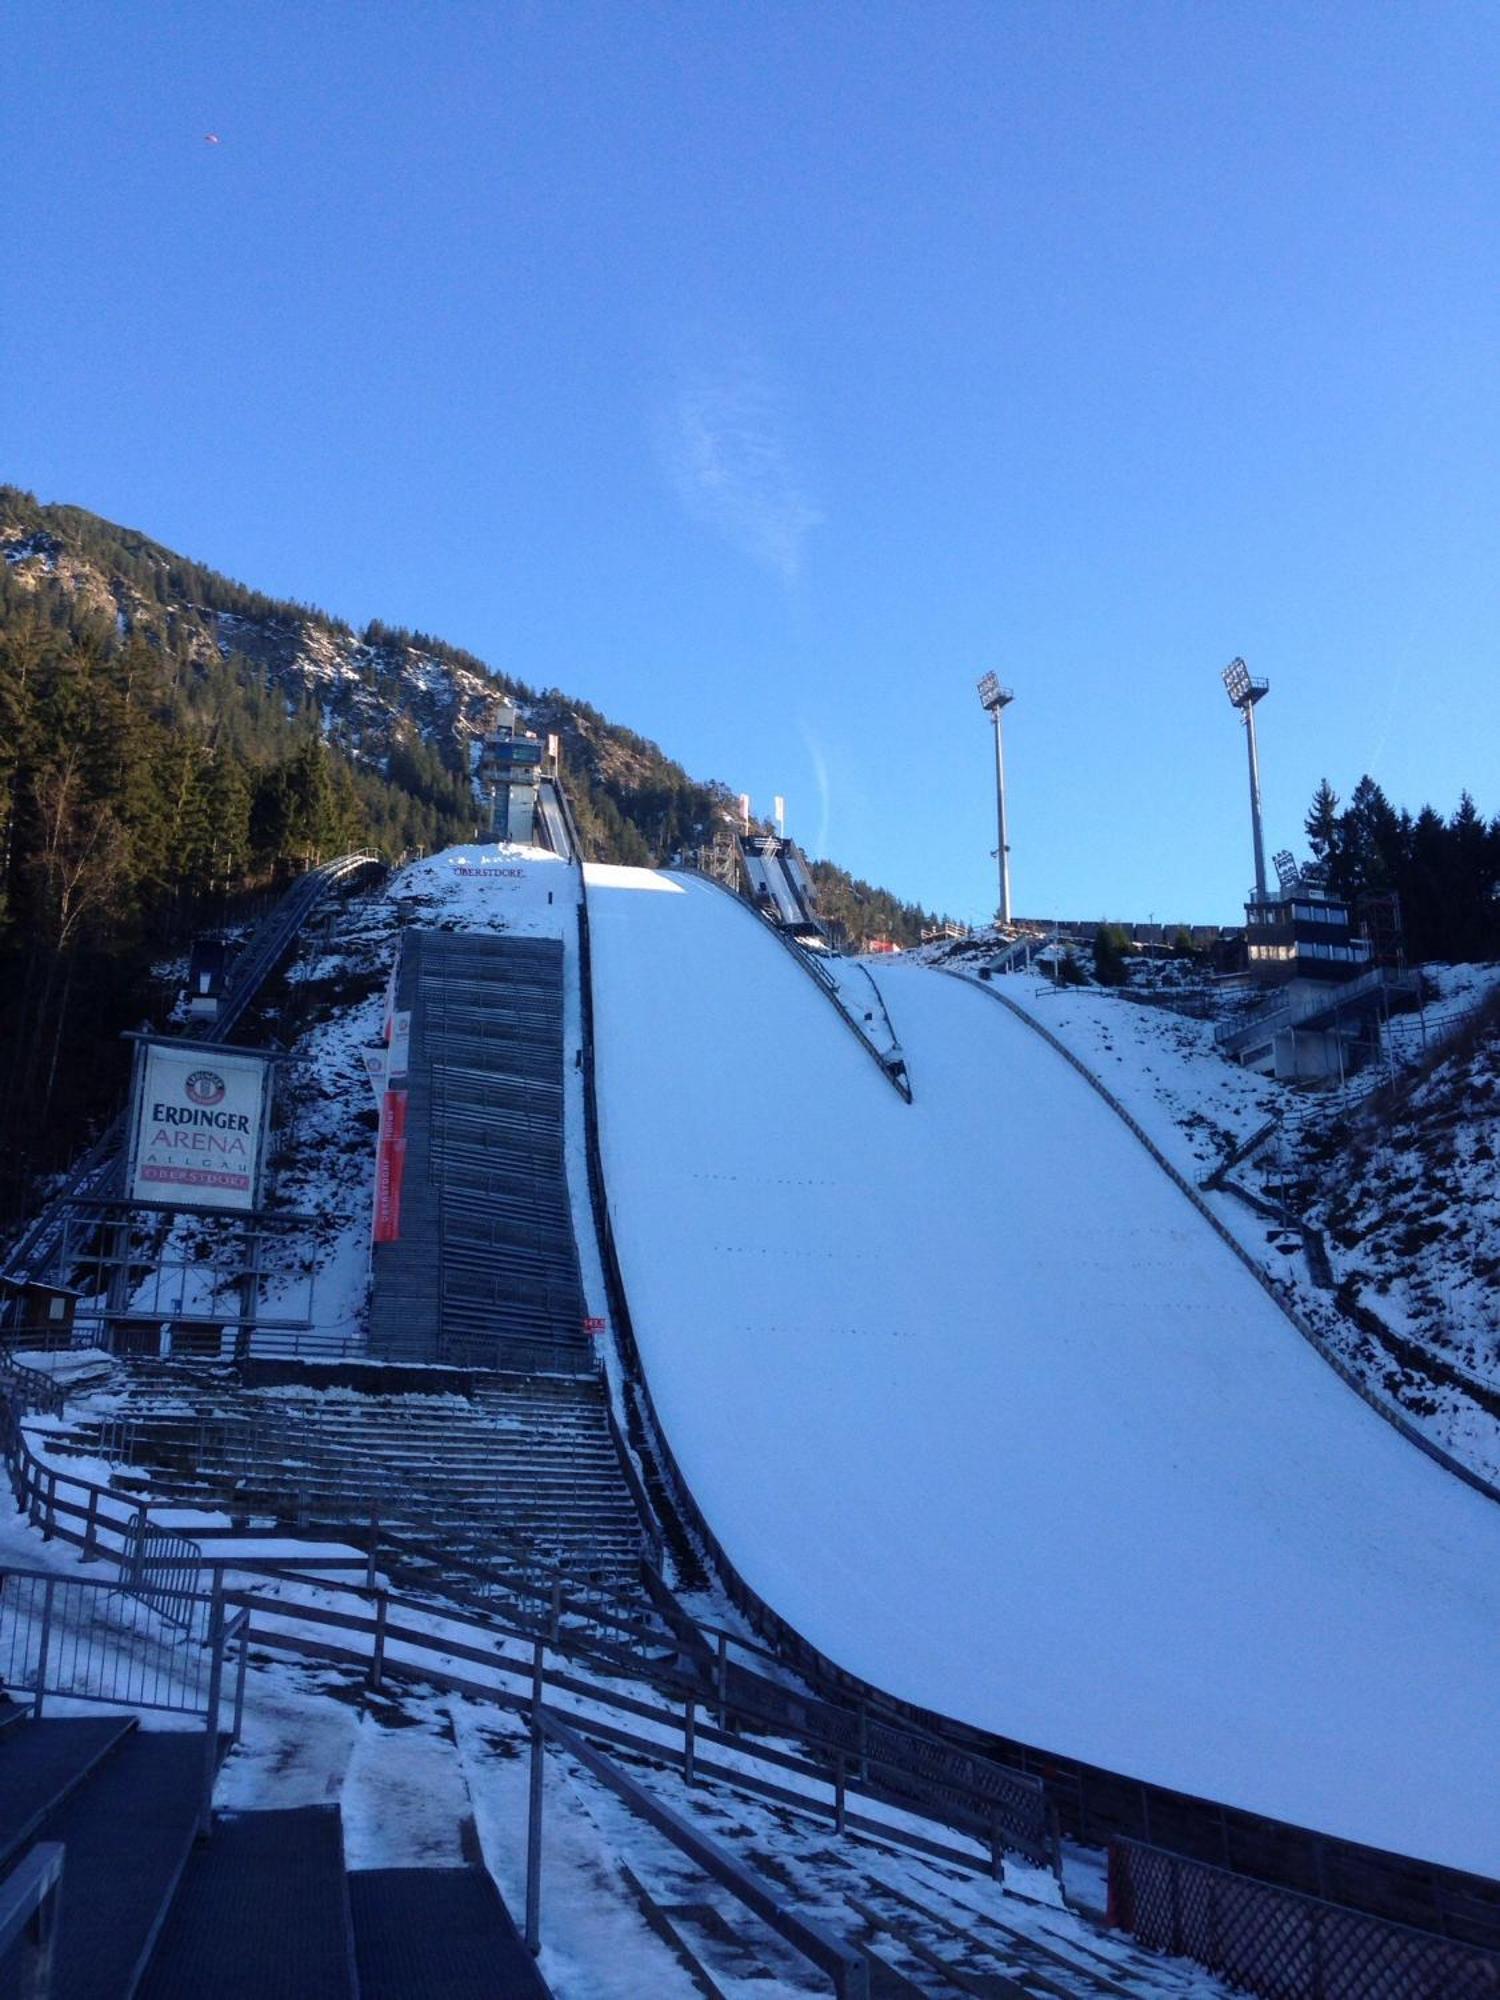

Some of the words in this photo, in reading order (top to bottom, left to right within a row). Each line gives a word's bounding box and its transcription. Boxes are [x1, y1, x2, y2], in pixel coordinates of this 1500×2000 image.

[454, 867, 523, 878] OBERSTDORF
[152, 1103, 250, 1134] ERDINGER
[150, 1129, 246, 1153] ARENA
[144, 1169, 248, 1187] OBERSTDORF
